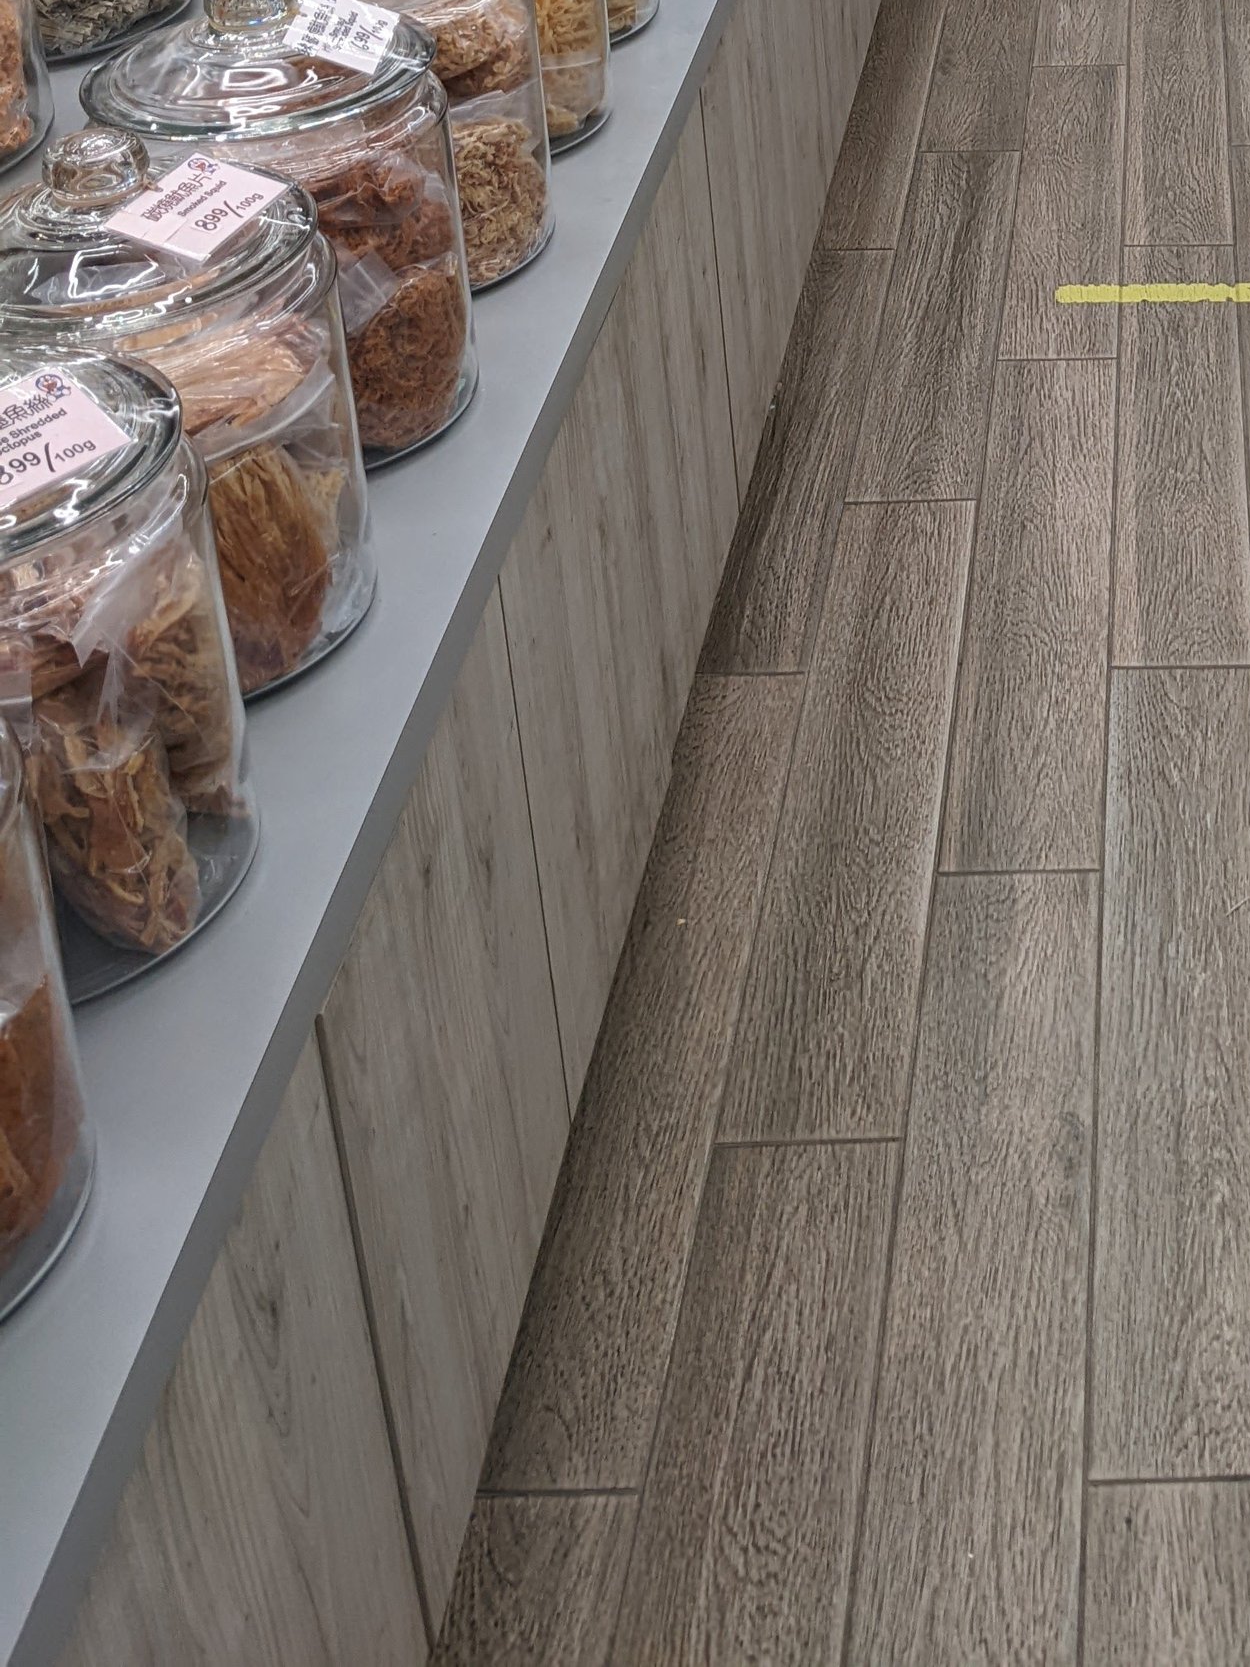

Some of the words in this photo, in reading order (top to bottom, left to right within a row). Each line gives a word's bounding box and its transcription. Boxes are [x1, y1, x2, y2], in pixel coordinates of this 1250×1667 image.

[177, 190, 208, 217] Smoked
[203, 180, 227, 201] Squid
[9, 407, 68, 439] Shredded
